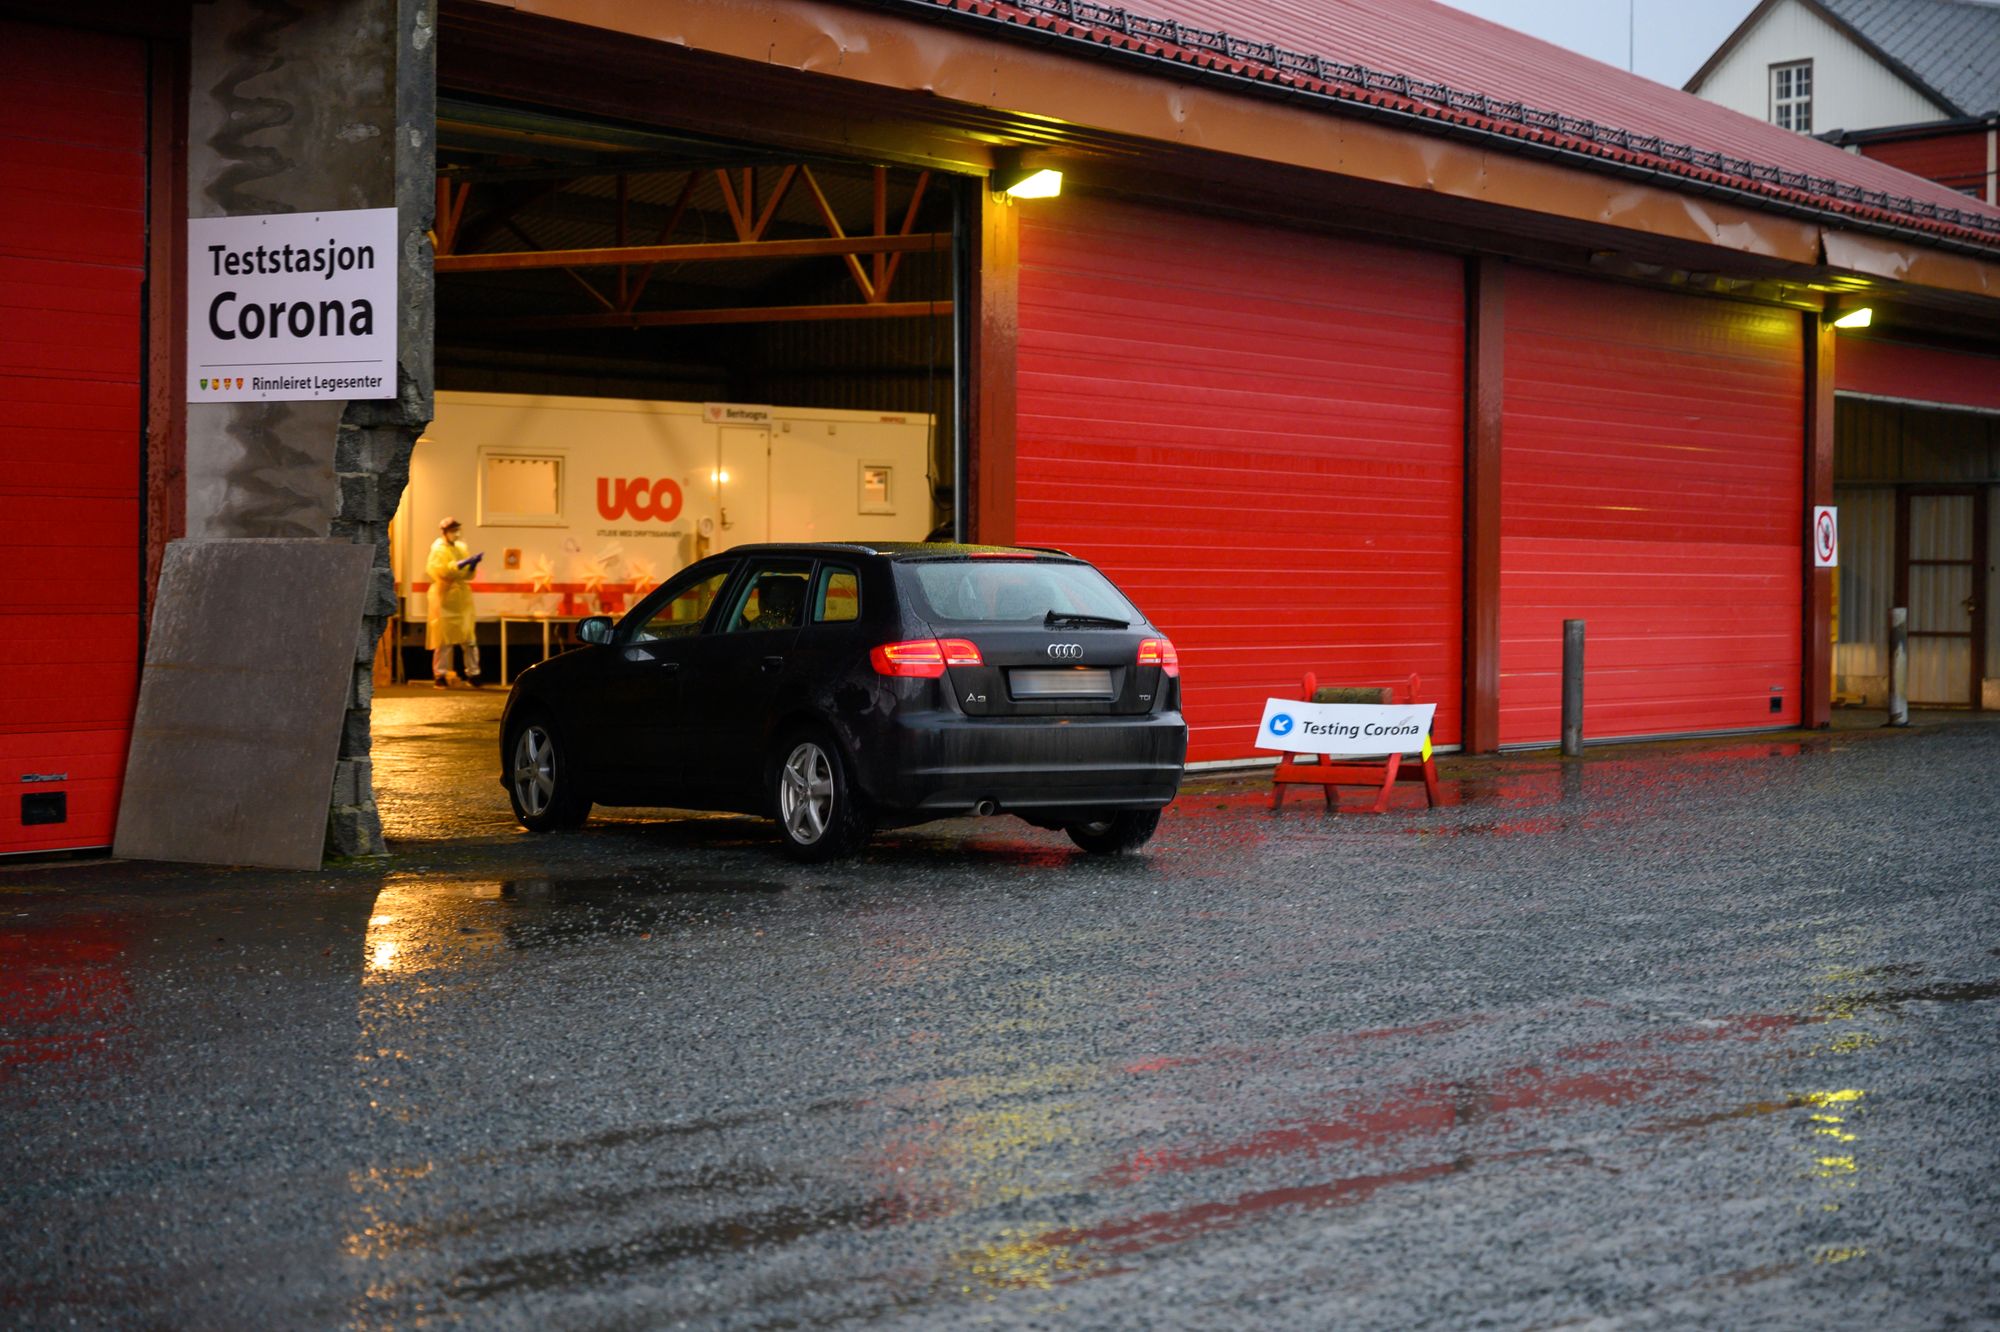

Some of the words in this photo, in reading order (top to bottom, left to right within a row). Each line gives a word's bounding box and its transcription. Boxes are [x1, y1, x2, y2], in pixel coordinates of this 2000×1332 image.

[208, 238, 375, 281] Teststasjon
[208, 291, 375, 341] Corona
[252, 376, 312, 390] Rinnleiret
[314, 375, 383, 392] Legesenter
[597, 477, 683, 522] UCO
[965, 692, 986, 703] A3
[1303, 721, 1360, 739] Testing
[1363, 723, 1420, 736] Corona
